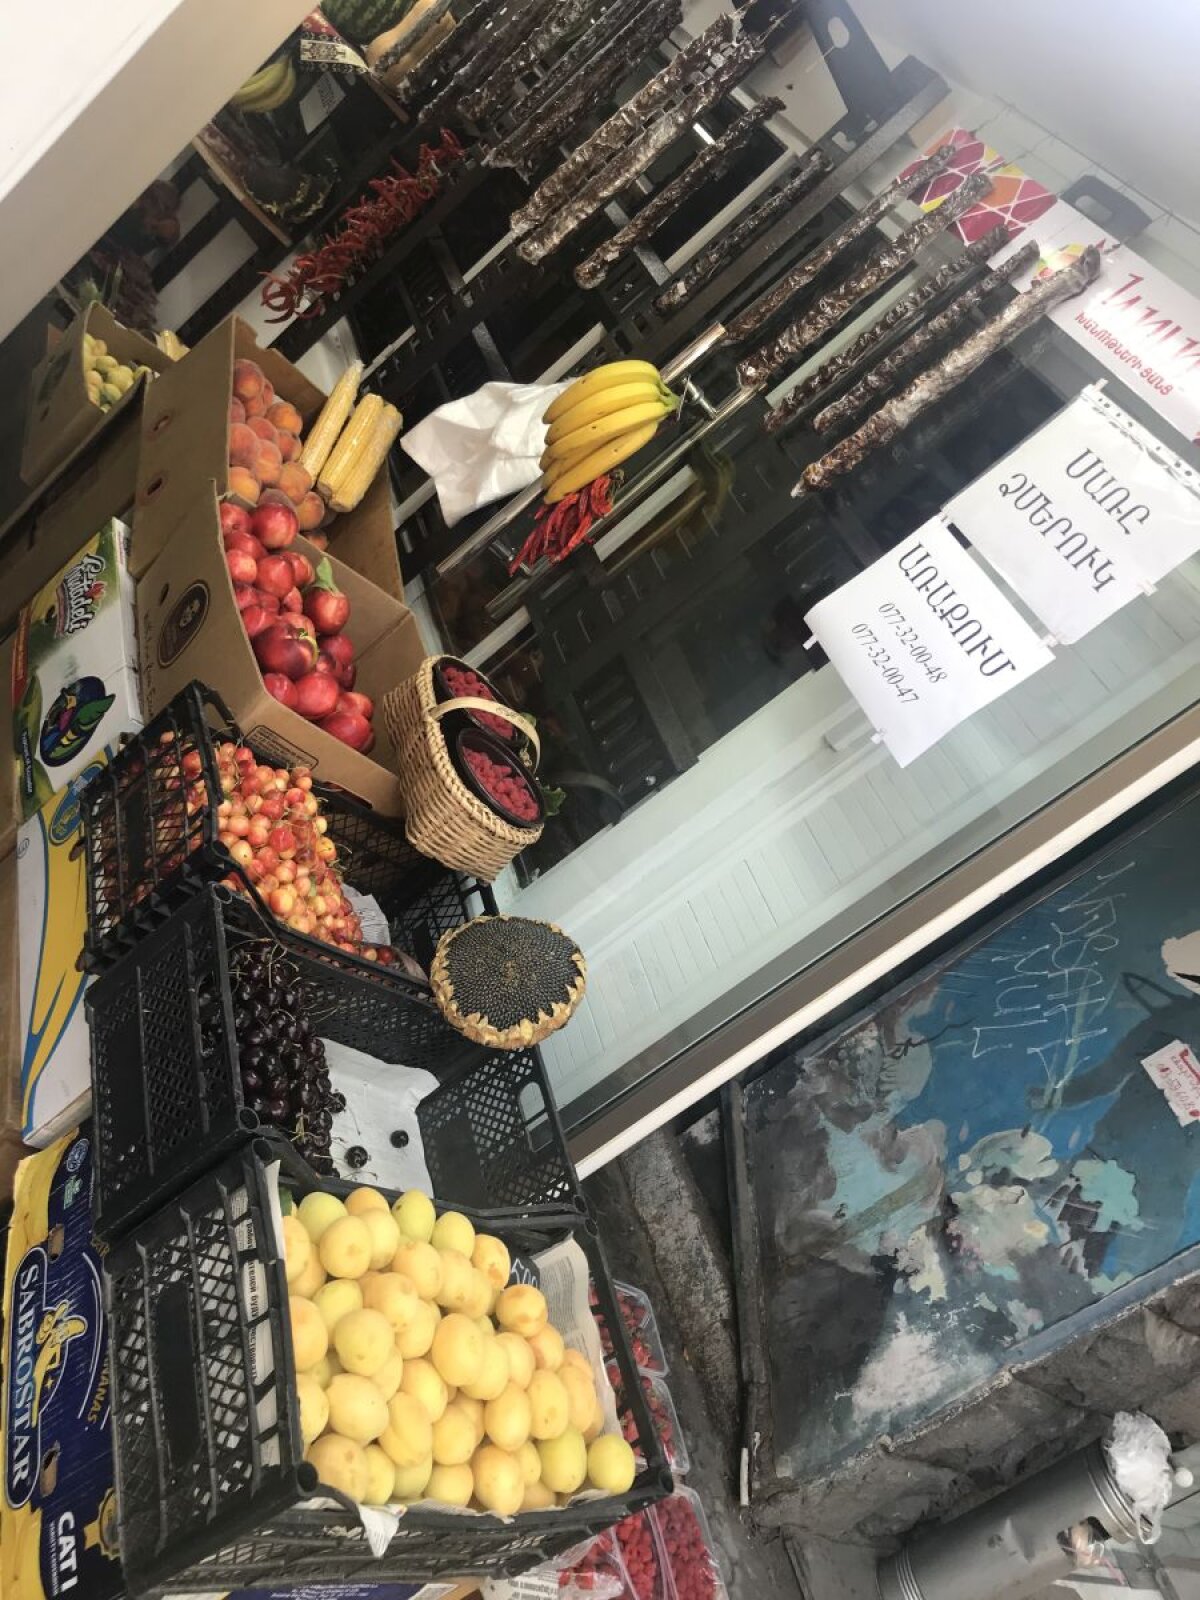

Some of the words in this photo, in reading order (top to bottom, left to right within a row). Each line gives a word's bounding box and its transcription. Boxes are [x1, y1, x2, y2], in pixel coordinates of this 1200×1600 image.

[999, 473, 1115, 593] ՁՄԵՐՈՒԿ
[1066, 447, 1150, 536] ՍԱՌԸ
[878, 602, 947, 684] 077-32-00-48
[898, 542, 1016, 677] ԱՌԱՔՈՒՄ
[851, 623, 919, 704] 077-32-00-47
[11, 1263, 39, 1486] SABROSTAR
[87, 1342, 109, 1424] NANAS
[58, 1511, 77, 1572] CAT
